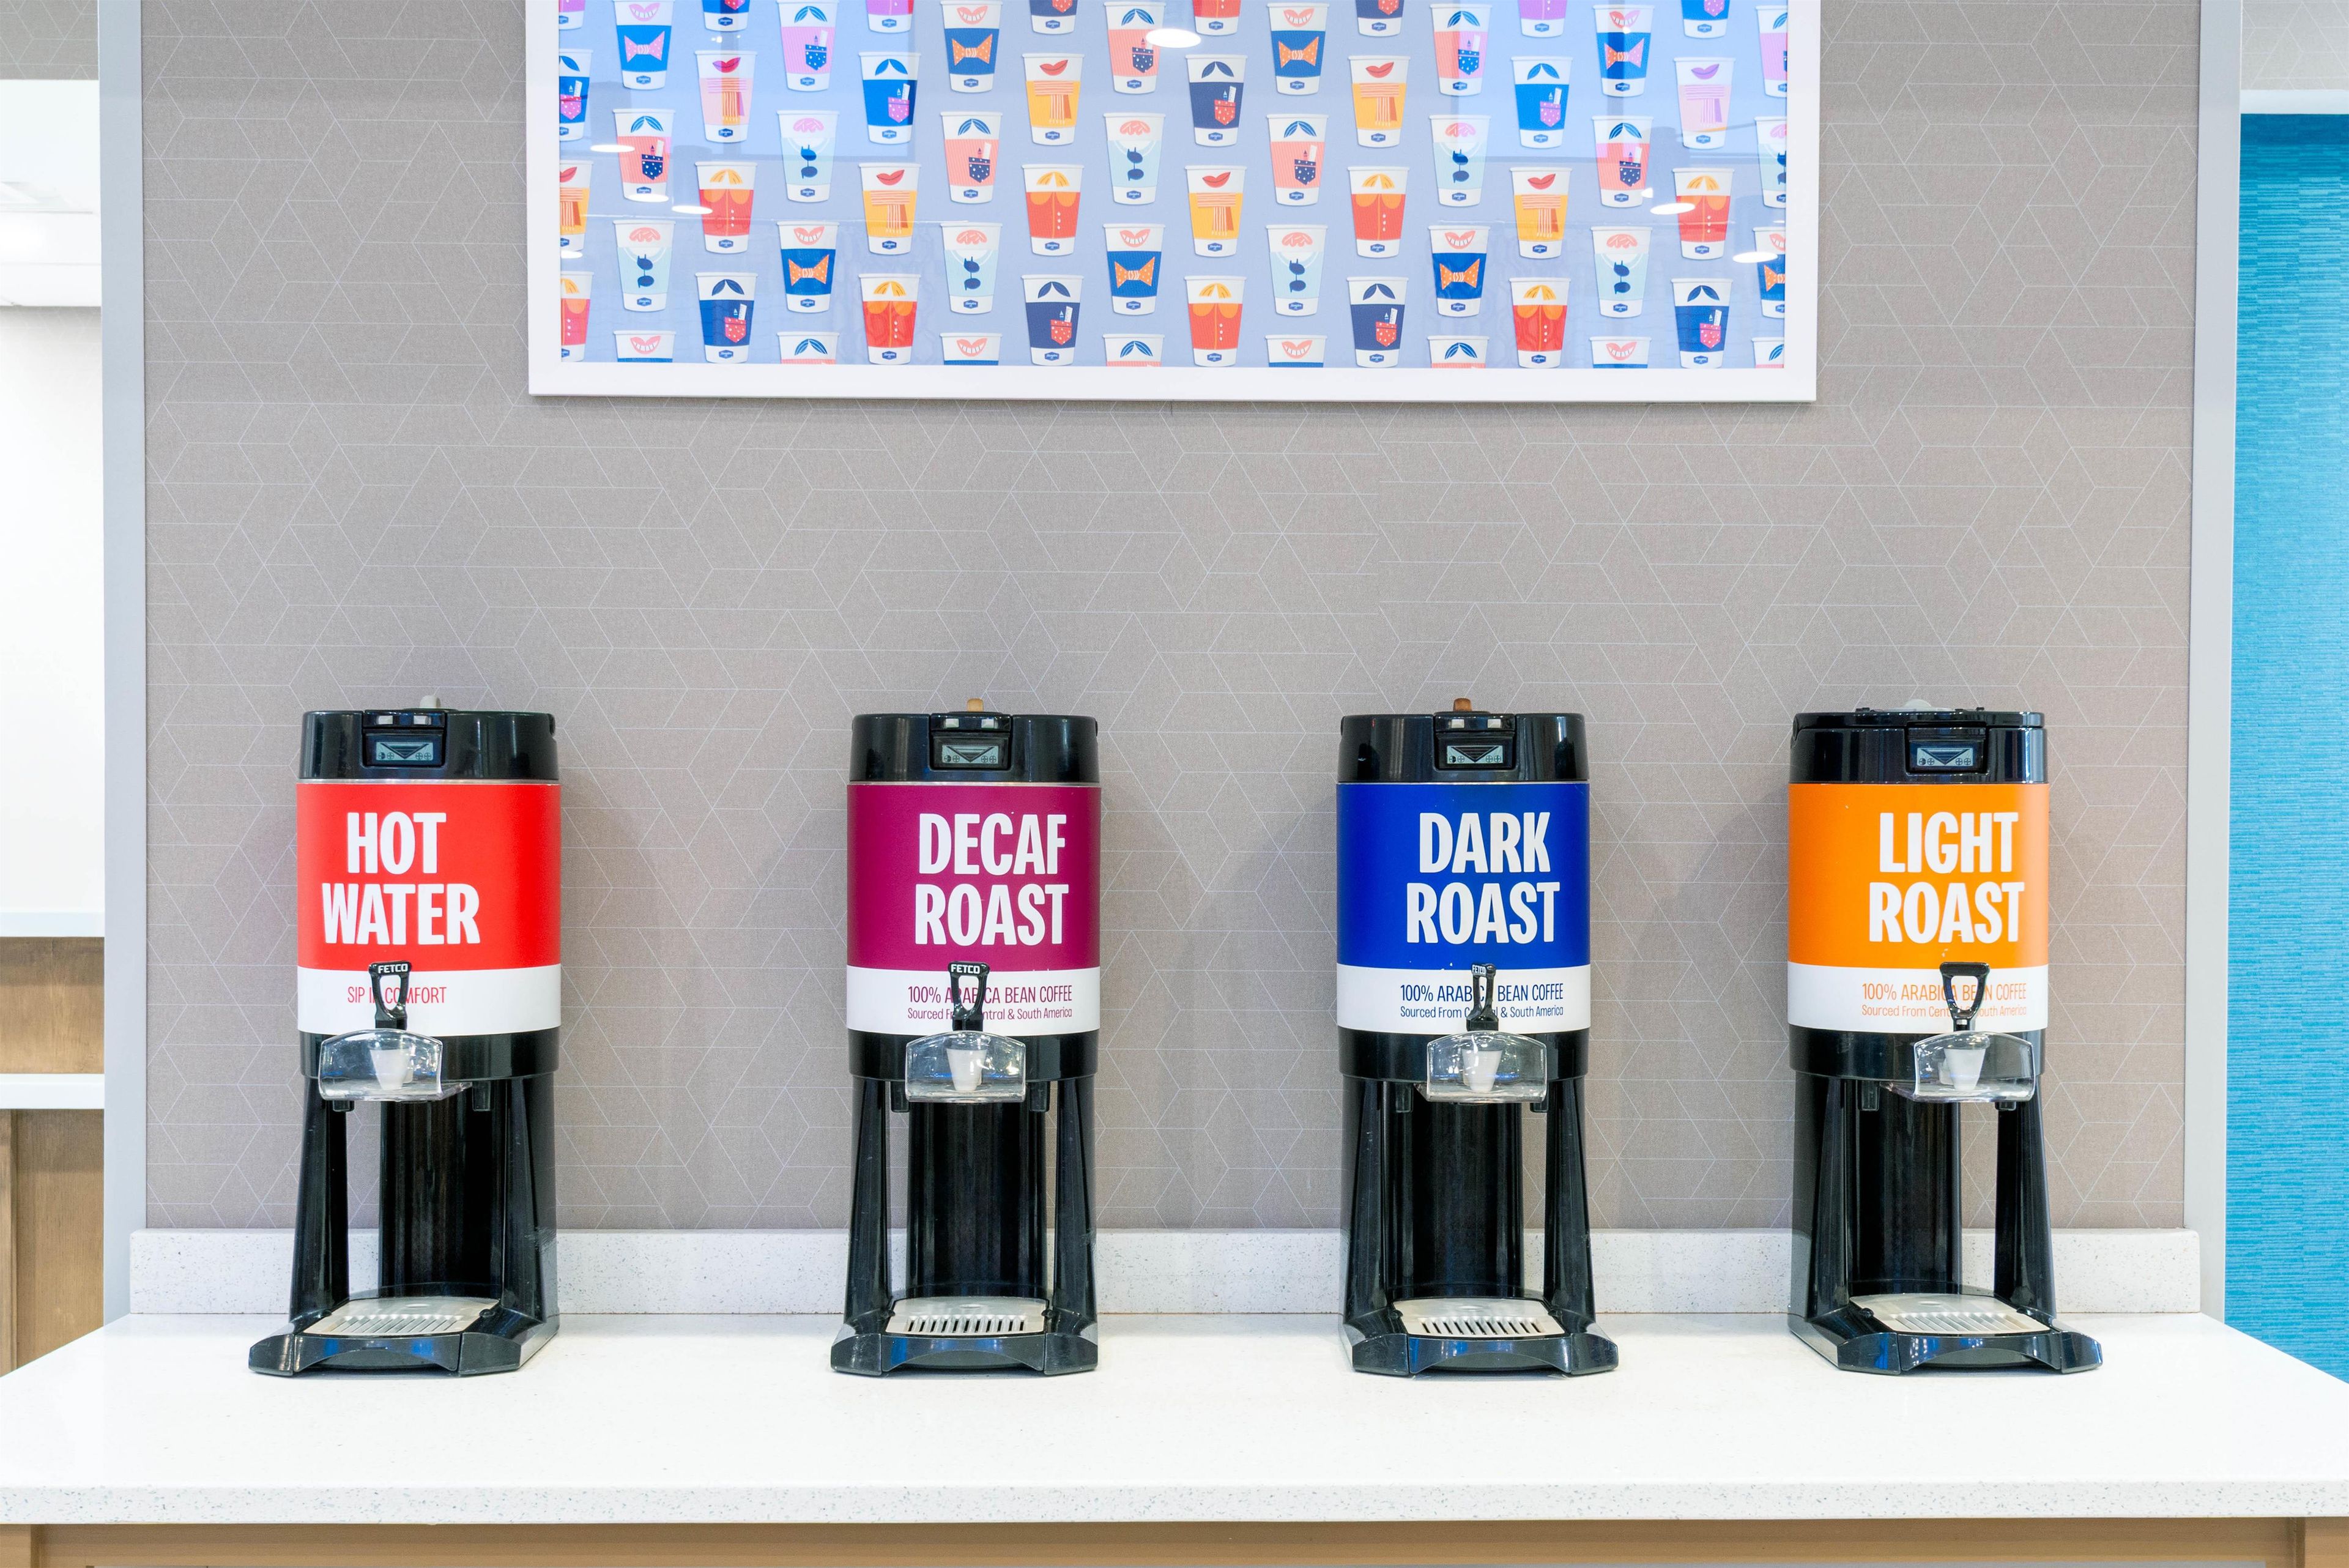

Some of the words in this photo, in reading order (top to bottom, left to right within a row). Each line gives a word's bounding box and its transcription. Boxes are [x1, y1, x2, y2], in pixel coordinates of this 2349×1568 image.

[347, 811, 447, 875] HOT
[919, 813, 1066, 875] DECAF
[1419, 812, 1551, 873] DARK
[1879, 812, 2019, 874] LIGHT
[321, 883, 480, 945] WATER
[915, 884, 1069, 946] ROAST
[1406, 881, 1560, 945] ROAST
[1869, 881, 2025, 943] ROAST
[378, 964, 408, 974] FETCO
[951, 964, 980, 974] FETCO
[347, 986, 365, 1003] SIP
[908, 986, 941, 1003] 100%
[1005, 986, 1036, 1003] BEAN
[1039, 985, 1072, 1003] COFFEE
[1400, 984, 1433, 1001] 100%
[1497, 985, 1528, 1001] BEAN
[1532, 983, 1564, 1001] COFFEE
[1862, 983, 1897, 1000] 100%
[1962, 984, 1992, 1001] BEN
[1996, 983, 2027, 1000] COFFEE
[908, 1007, 943, 1019] Sourced
[982, 1008, 1005, 1020] ntral
[1008, 1009, 1015, 1019] &
[1017, 1008, 1042, 1019] South
[1044, 1006, 1072, 1019] America
[1400, 1006, 1436, 1017] Sourced
[1439, 1007, 1462, 1018] From
[1501, 1006, 1508, 1018] &
[1510, 1006, 1534, 1017] South
[1535, 1005, 1564, 1017] America
[1861, 1005, 1899, 1017] Sourced
[1902, 1006, 1926, 1017] From
[1978, 1005, 1997, 1017] outh
[2000, 1004, 2027, 1016] America
